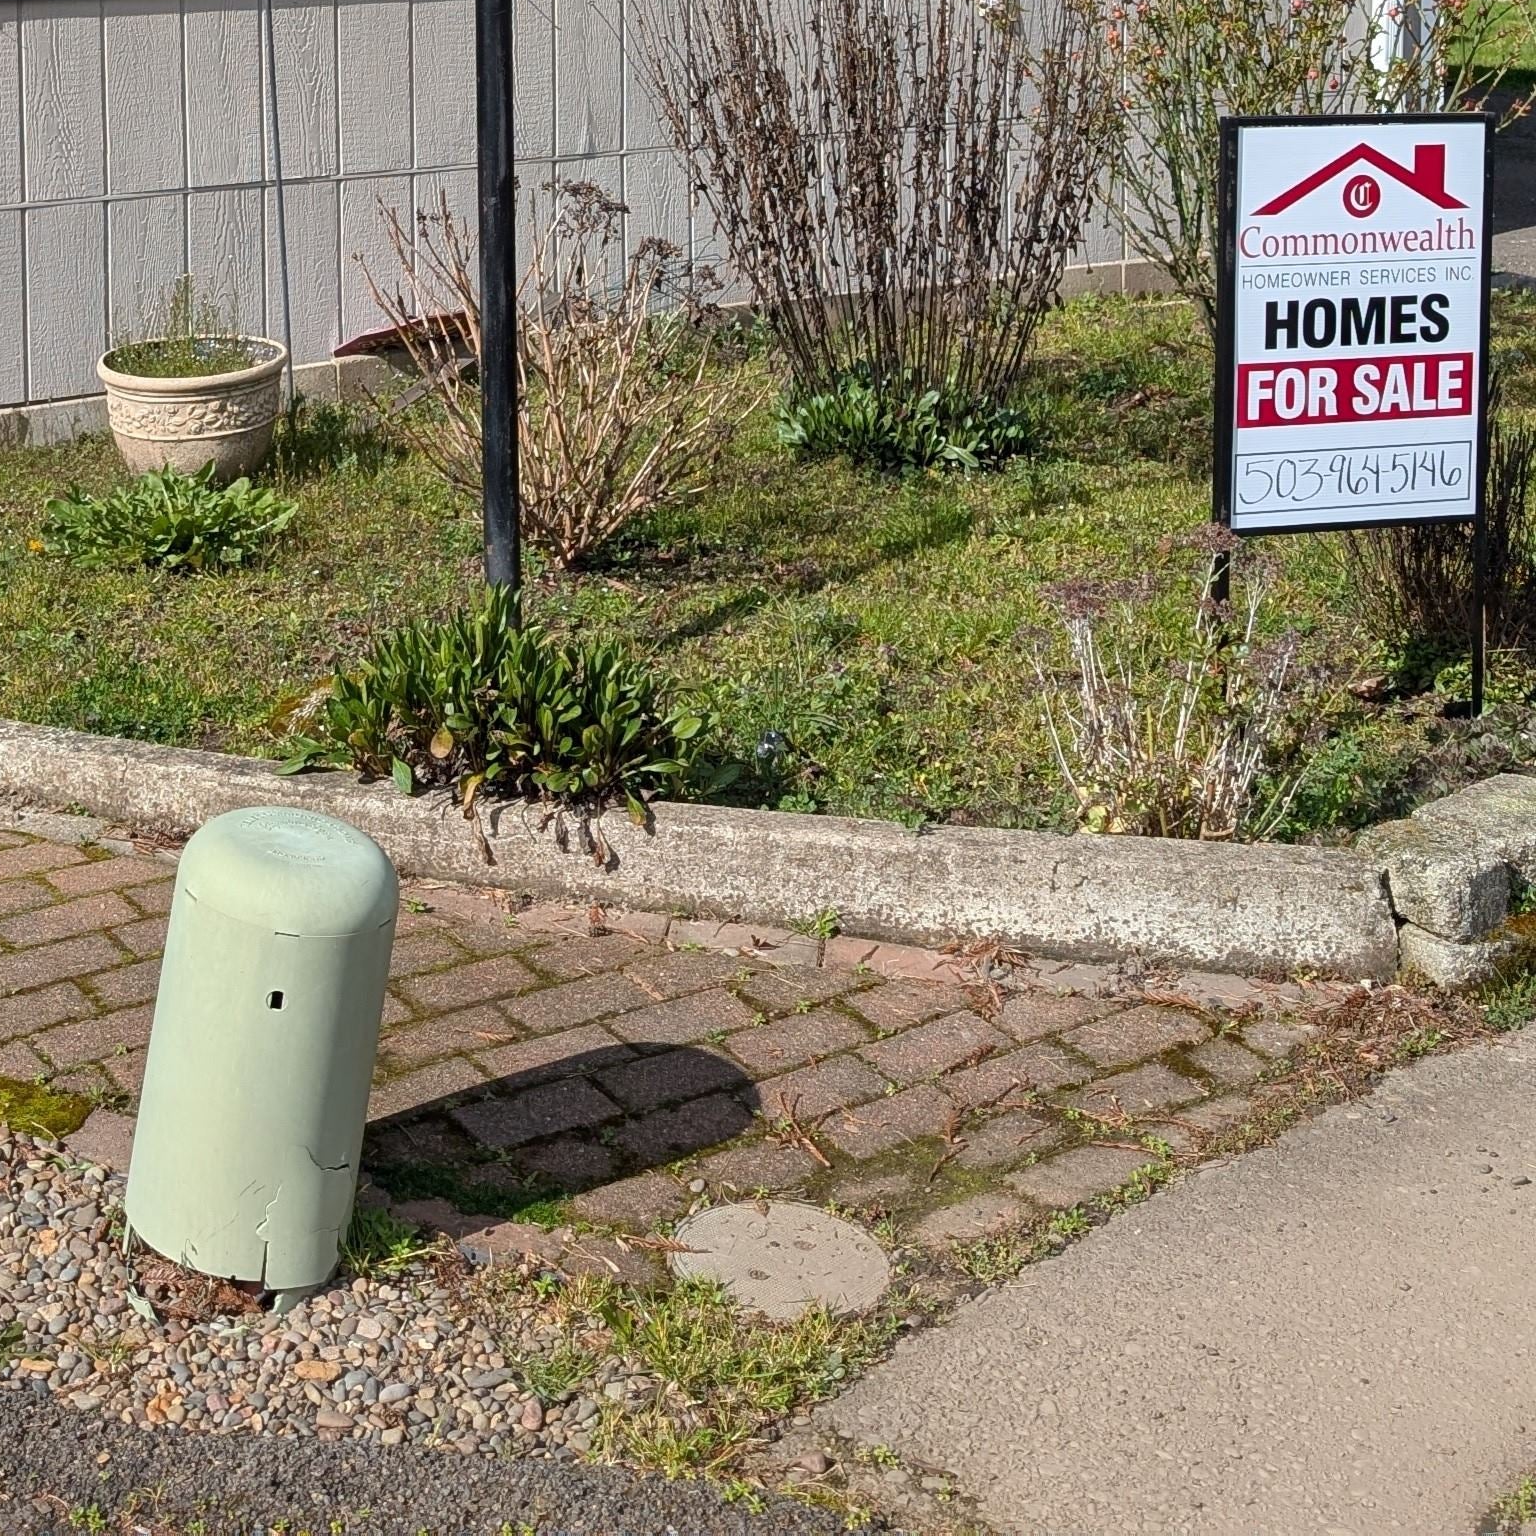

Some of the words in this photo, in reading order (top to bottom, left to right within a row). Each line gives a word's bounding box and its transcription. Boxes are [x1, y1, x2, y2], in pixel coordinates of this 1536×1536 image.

[1240, 217, 1476, 259] Commonwealth
[1242, 271, 1351, 289] HOMEOWNER
[1359, 267, 1436, 285] SERVICES
[1445, 266, 1475, 281] INC.
[1264, 293, 1450, 350] HOMES
[1247, 367, 1339, 421] FOR
[1352, 360, 1464, 415] SALE
[1239, 450, 1462, 504] 503-964-5146
